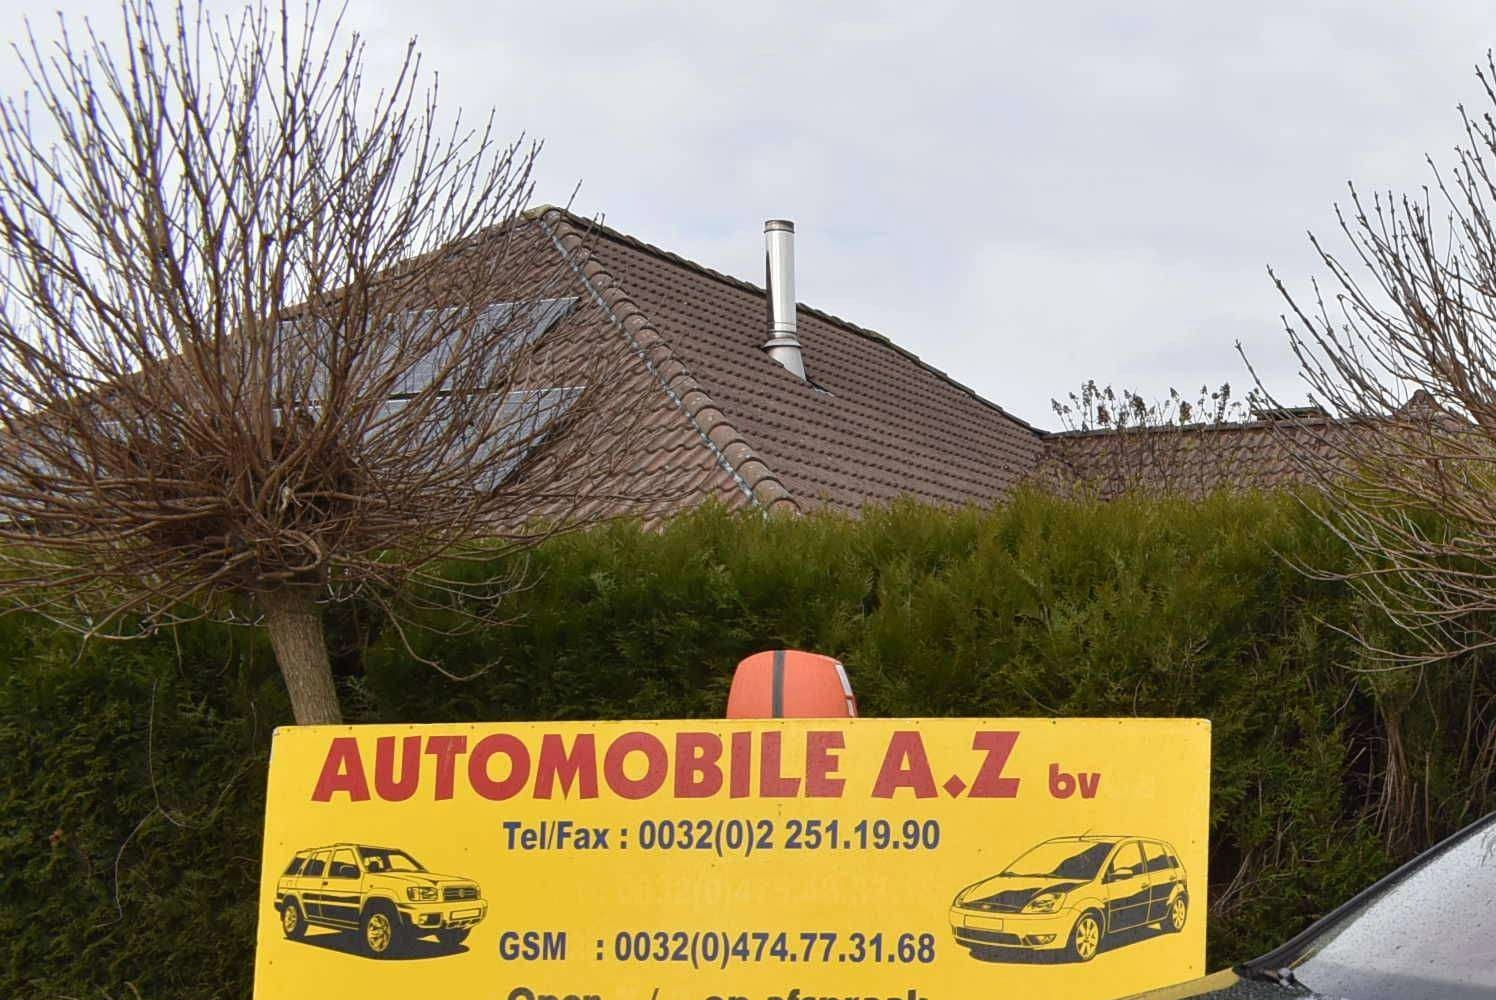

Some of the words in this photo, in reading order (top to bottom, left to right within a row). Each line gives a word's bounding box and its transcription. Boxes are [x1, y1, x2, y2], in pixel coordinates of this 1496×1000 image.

[311, 731, 846, 803] AUTOMOBILE
[871, 731, 1021, 799] A.Z
[1048, 763, 1101, 800] bv
[502, 820, 609, 850] Tel/Fax
[639, 819, 774, 857] 0032(0)2
[784, 819, 940, 850] 251.19.90
[499, 931, 567, 961] GSM
[614, 931, 935, 970] 0032(0)474.77.31.68
